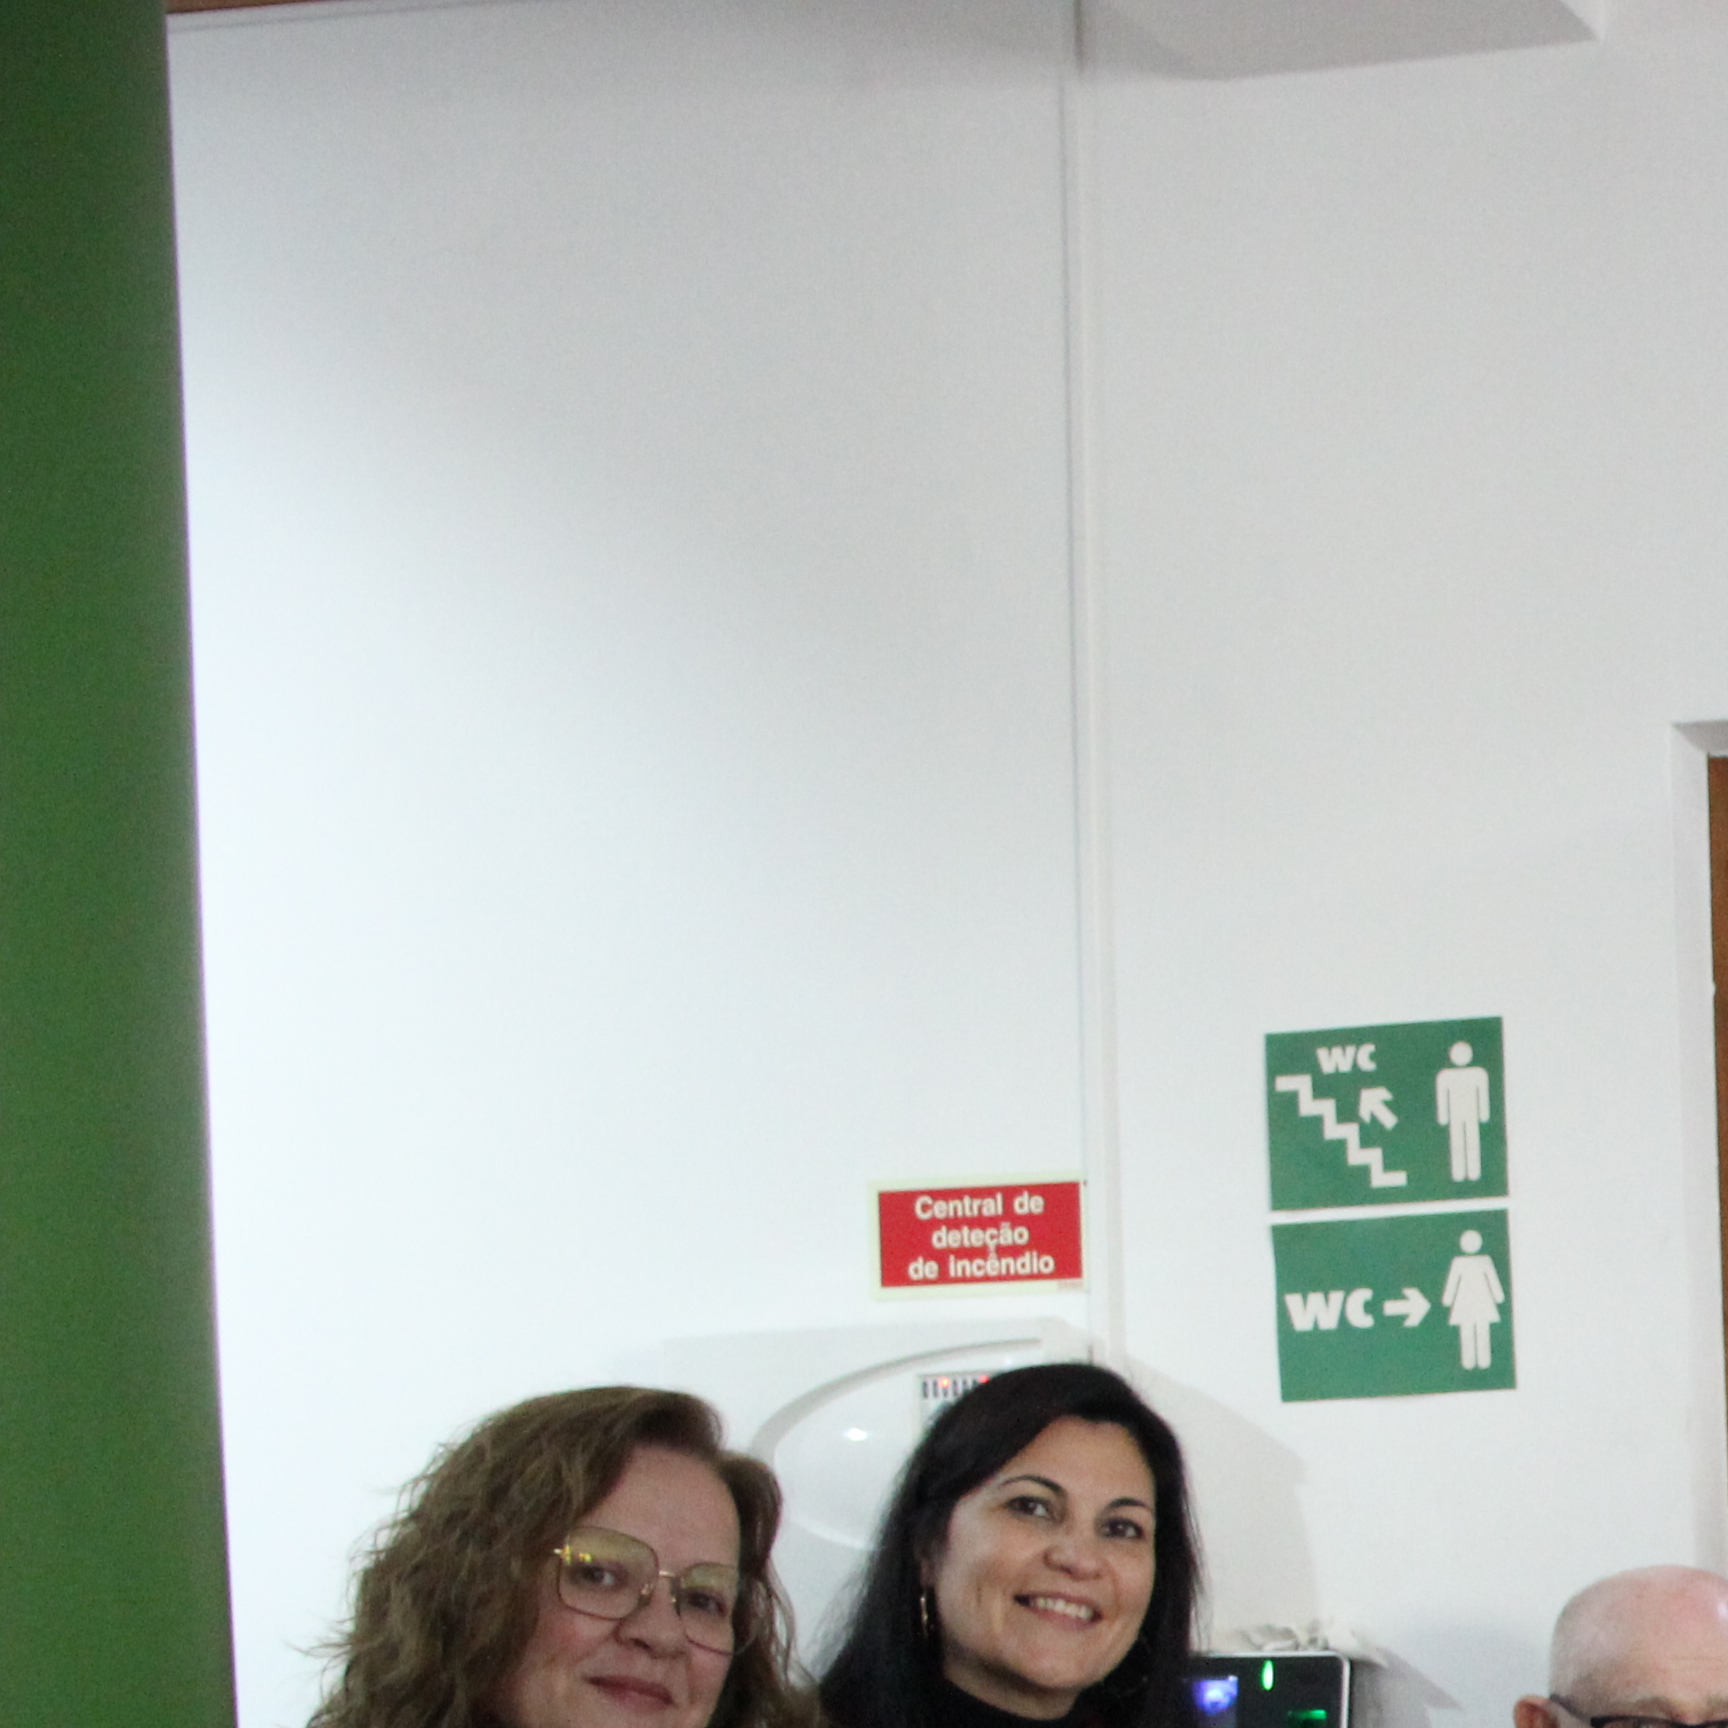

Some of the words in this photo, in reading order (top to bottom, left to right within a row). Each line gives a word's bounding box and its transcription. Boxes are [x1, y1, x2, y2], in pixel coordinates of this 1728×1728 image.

[1316, 1043, 1376, 1074] WC
[915, 1193, 1003, 1220] Central
[1014, 1191, 1044, 1215] de
[931, 1223, 1029, 1252] deteção
[908, 1256, 939, 1280] de
[949, 1249, 1055, 1278] incêndio
[1285, 1288, 1374, 1331] WC
